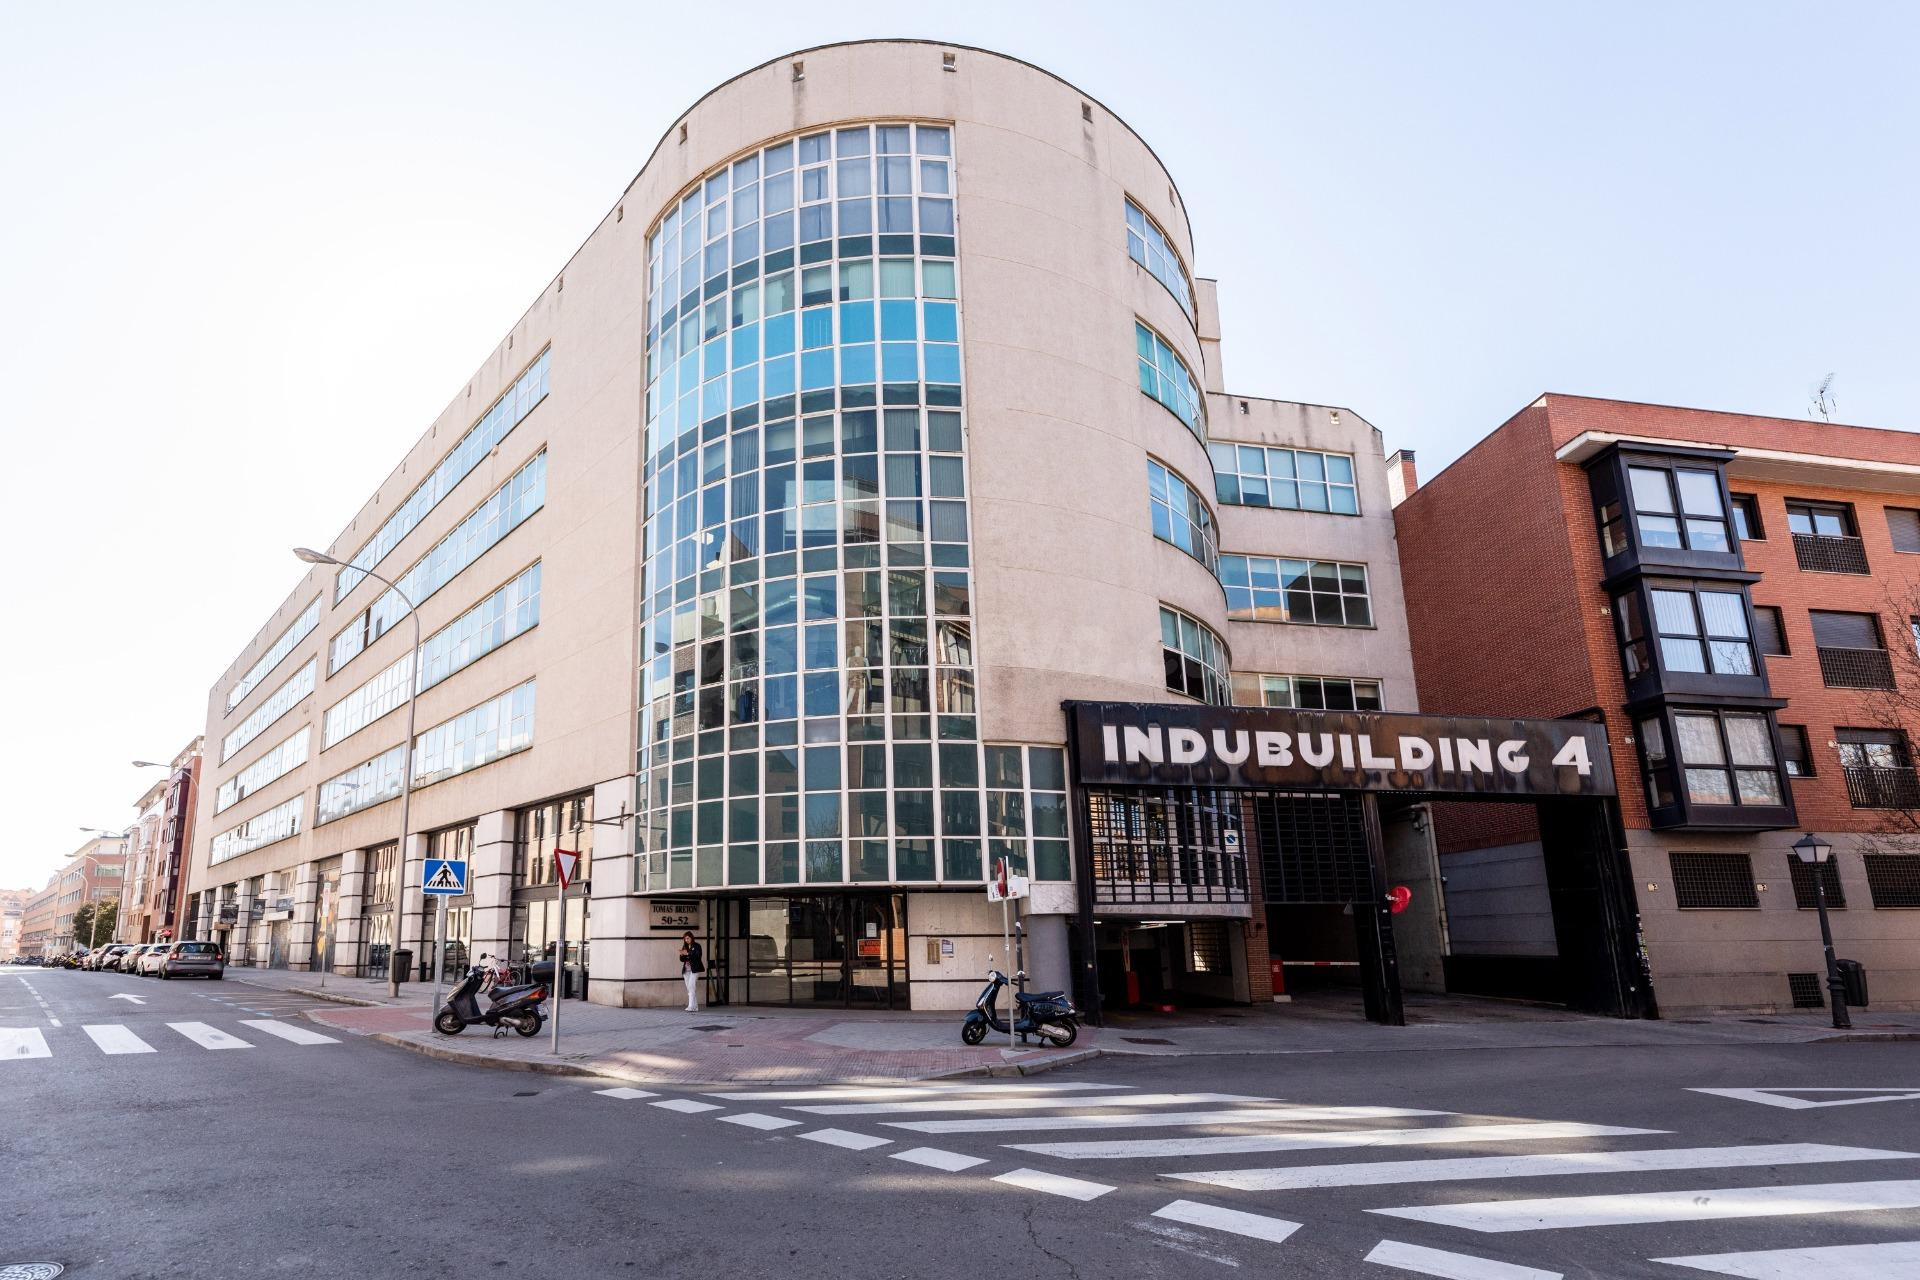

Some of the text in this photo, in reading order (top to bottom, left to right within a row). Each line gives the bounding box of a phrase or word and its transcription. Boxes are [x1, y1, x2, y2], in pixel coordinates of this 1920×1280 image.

[1102, 724, 1593, 775] INDUBUILDING 4
[661, 916, 689, 925] 50-52
